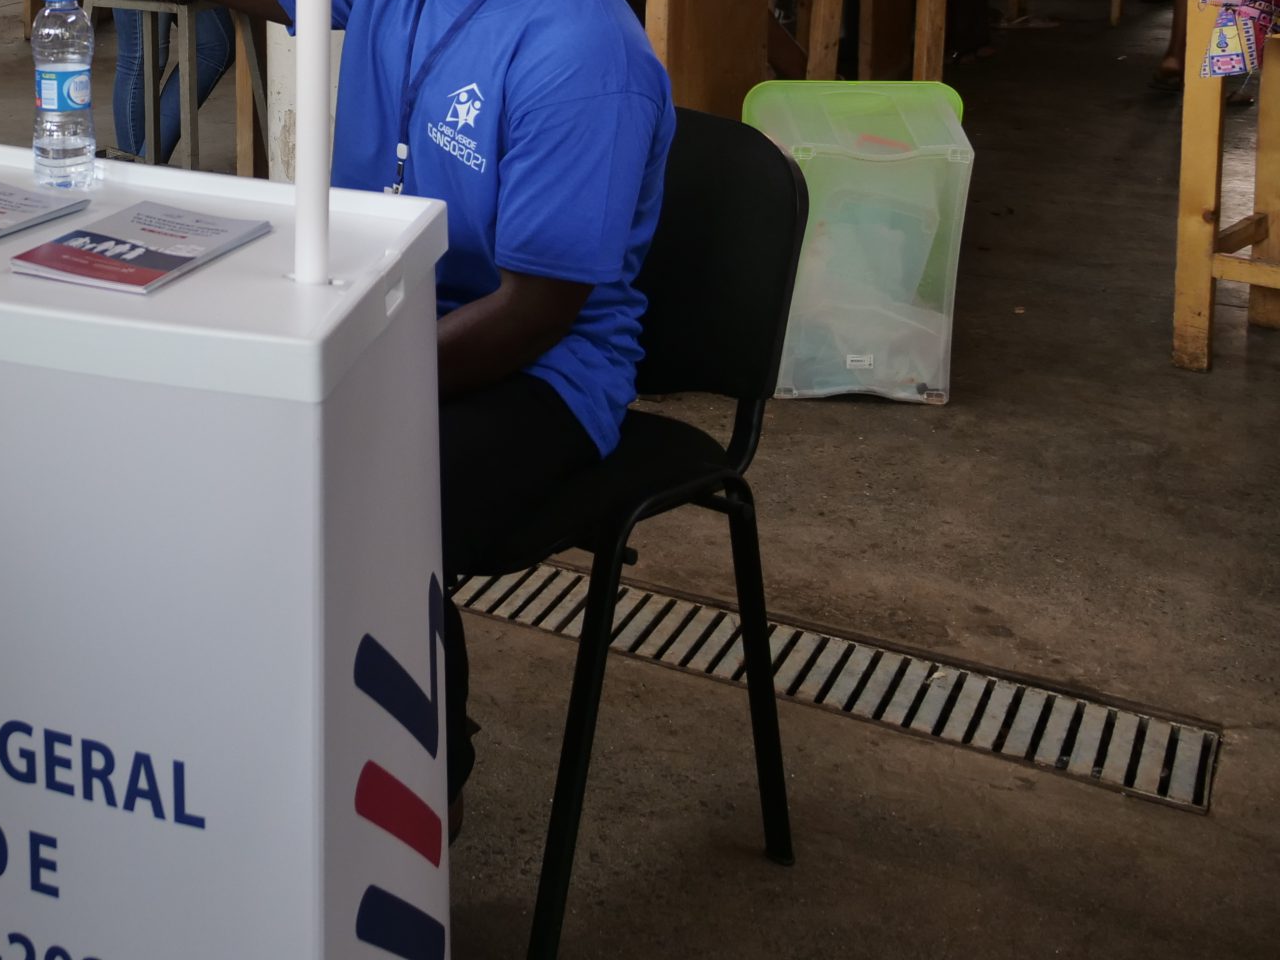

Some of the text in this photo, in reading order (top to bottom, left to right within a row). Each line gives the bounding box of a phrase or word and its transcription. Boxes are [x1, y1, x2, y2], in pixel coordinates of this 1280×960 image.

[428, 122, 486, 173] CENSO2021
[438, 122, 477, 150] CABO VERDE
[29, 830, 60, 898] E
